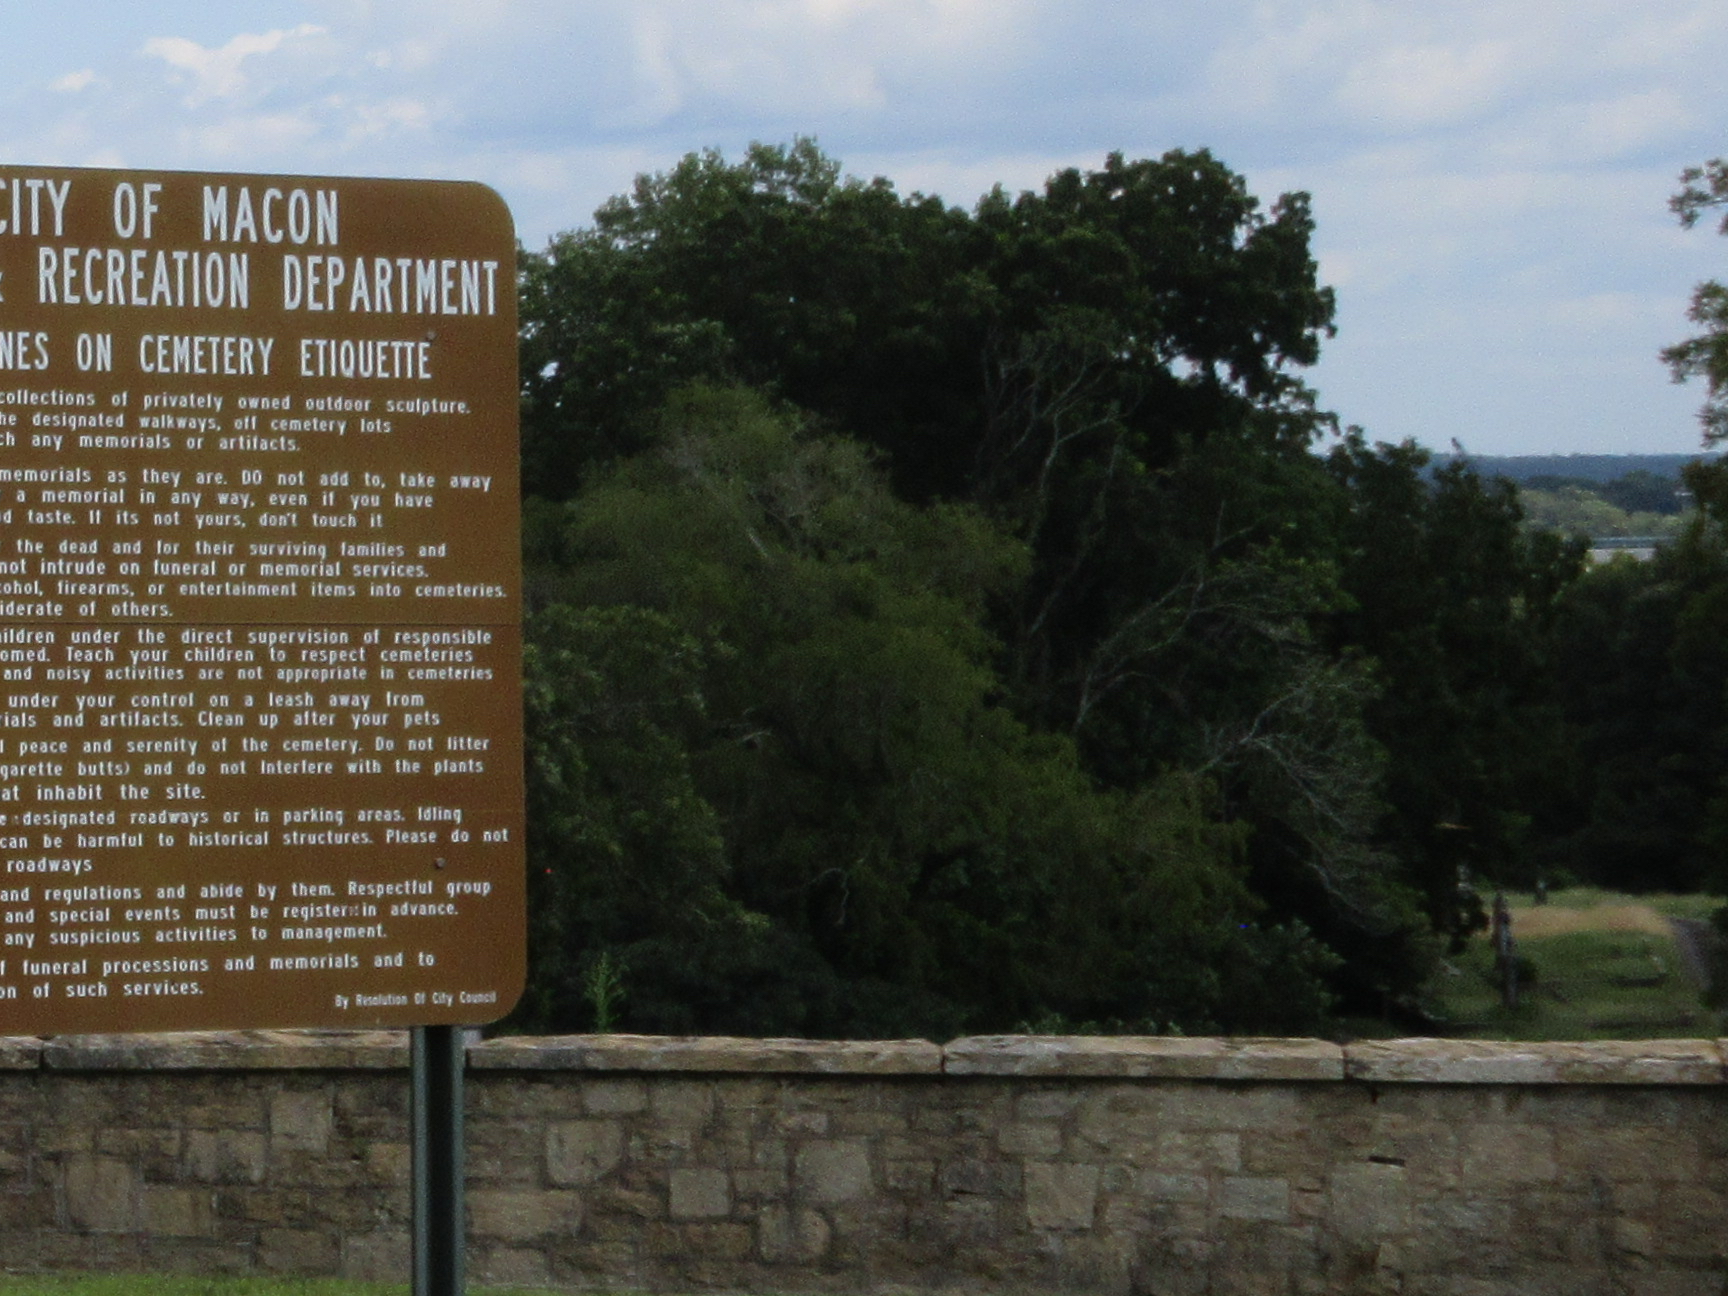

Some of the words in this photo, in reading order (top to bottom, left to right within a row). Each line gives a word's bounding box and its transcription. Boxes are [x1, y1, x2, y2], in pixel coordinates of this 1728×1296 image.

[112, 181, 162, 239] OF
[202, 184, 338, 246] MACON
[38, 245, 249, 309] RECREATION
[283, 254, 499, 316] DEPARTMENT
[76, 332, 112, 372] ON
[139, 333, 274, 376] CEMETERY
[300, 338, 432, 379] ETIQUETTE
[111, 390, 128, 407] of
[143, 391, 223, 412] privately
[237, 394, 291, 410] owned
[304, 395, 371, 412] outdoor
[386, 397, 470, 416] sculpture.
[31, 411, 125, 431] designated
[138, 413, 221, 433] walkways,
[233, 415, 257, 430] off
[269, 417, 347, 436] cemetery
[360, 417, 392, 433] lots
[31, 434, 63, 452] any
[78, 432, 171, 449] memorials
[185, 436, 203, 450] or
[218, 434, 300, 451] artifacts.
[107, 470, 127, 483] as
[142, 467, 181, 488] they
[195, 471, 227, 485] are.
[277, 470, 304, 486] not
[319, 471, 349, 487] add
[363, 471, 386, 489] to,
[399, 472, 435, 488] take
[449, 475, 491, 492] away
[15, 489, 26, 503] a
[41, 487, 125, 504] memorial
[139, 488, 156, 504] in
[170, 491, 202, 508] any
[217, 492, 255, 509] way,
[268, 493, 308, 506] even
[321, 490, 335, 506] if
[350, 494, 380, 511] you
[394, 491, 433, 508] have
[27, 508, 75, 525] taste.
[88, 508, 101, 525] If
[115, 510, 139, 525] its
[153, 510, 180, 526] not
[194, 513, 246, 530] yours,
[258, 511, 297, 527] don't
[311, 512, 357, 528] touch
[369, 513, 383, 528] it
[70, 628, 120, 644] under
[137, 627, 166, 644] the
[180, 628, 232, 644] direct
[247, 628, 349, 647] supervision
[362, 628, 380, 644] of
[393, 629, 492, 647] responsible
[66, 645, 115, 662] Teach
[129, 649, 169, 666] your
[183, 646, 254, 662] children
[269, 646, 286, 662] to
[300, 646, 366, 665] respect
[379, 646, 474, 663] cemeteries
[42, 833, 63, 849] be
[77, 832, 143, 848] harmful
[157, 832, 175, 847] to
[188, 830, 269, 847] historical
[282, 830, 372, 845] structures.
[385, 828, 437, 844] Please
[450, 828, 470, 843] do
[482, 827, 508, 842] not
[6, 856, 93, 876] roadways
[0, 886, 30, 902] and
[43, 885, 142, 905] regulations
[156, 883, 186, 899] and
[199, 883, 244, 899] abide
[257, 882, 277, 901] by
[290, 882, 335, 897] them.
[347, 879, 433, 898] Respectful
[446, 881, 491, 898] group
[22, 958, 87, 975] funeral
[102, 958, 209, 977] processions
[224, 954, 255, 971] and
[269, 952, 359, 970] memorials
[373, 951, 404, 968] and
[417, 951, 435, 967] to
[32, 981, 50, 998] of
[65, 980, 108, 998] such
[122, 979, 203, 996] services.
[431, 990, 454, 1007] City
